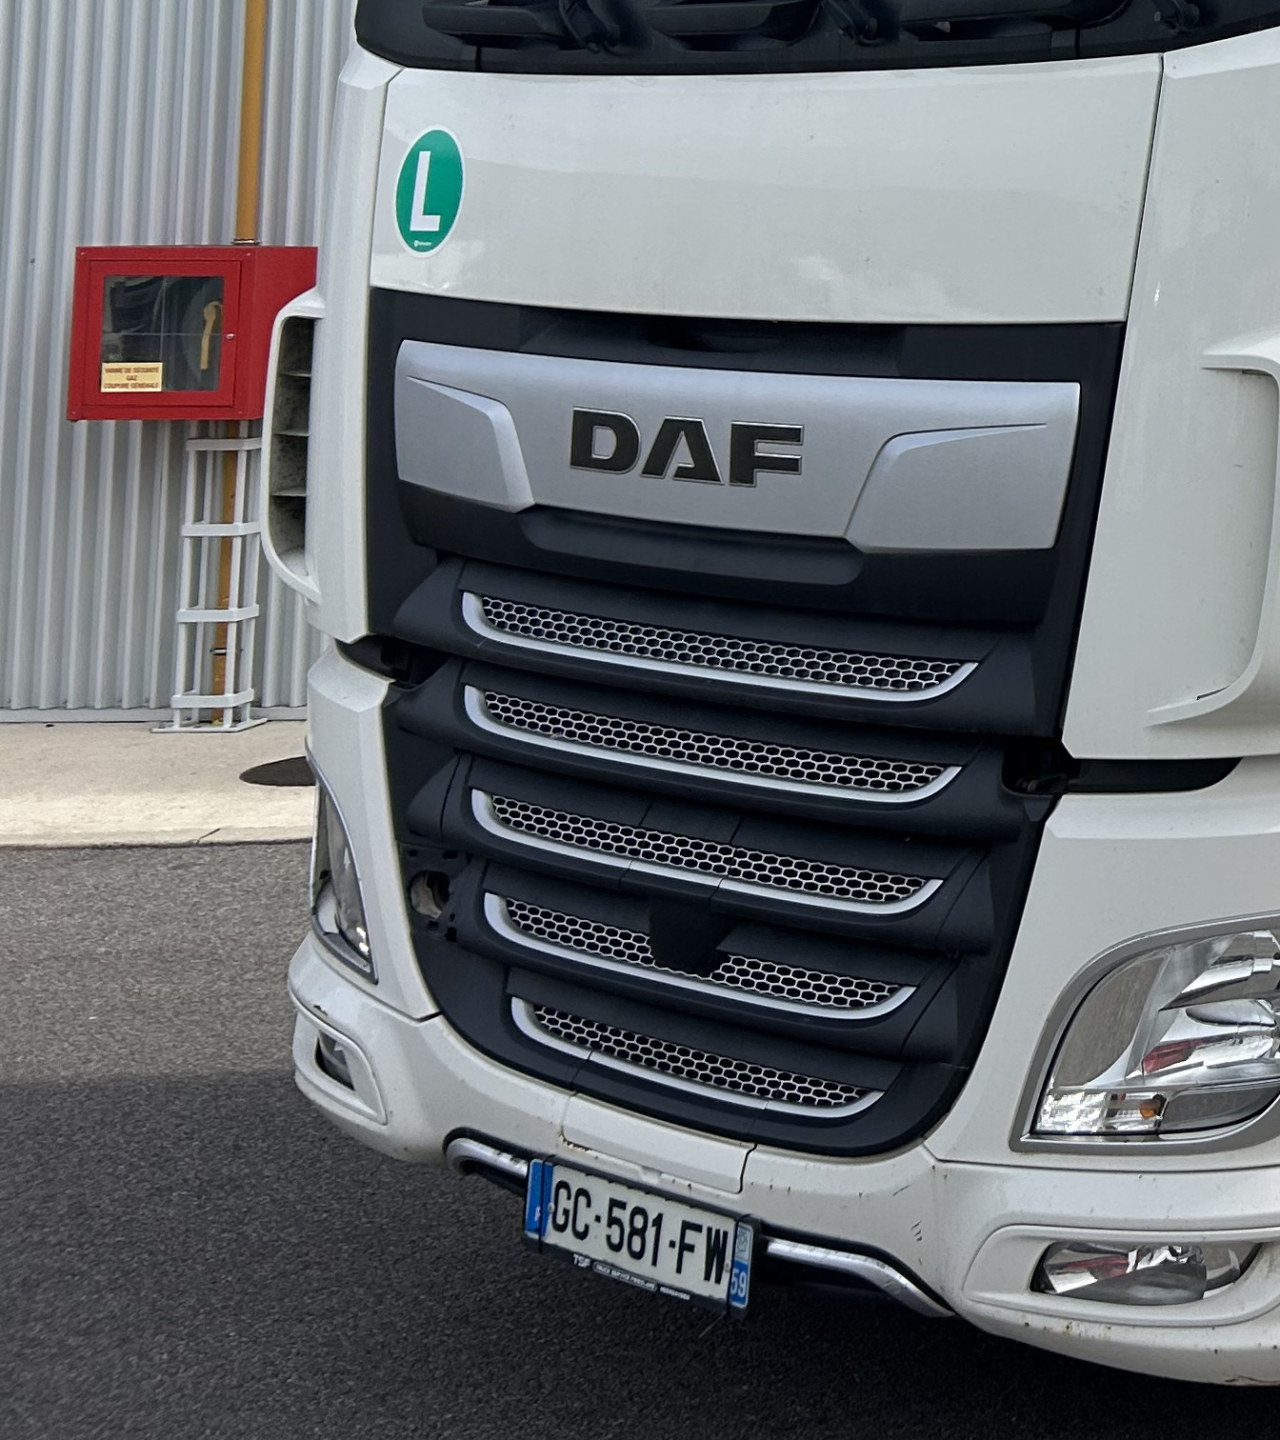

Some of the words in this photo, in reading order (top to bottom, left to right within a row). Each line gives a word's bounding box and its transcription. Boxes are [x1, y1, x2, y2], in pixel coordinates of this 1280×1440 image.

[409, 150, 441, 232] L
[570, 406, 804, 488] DAF
[551, 1179, 729, 1285] GC-581-FW
[731, 1267, 747, 1298] 59
